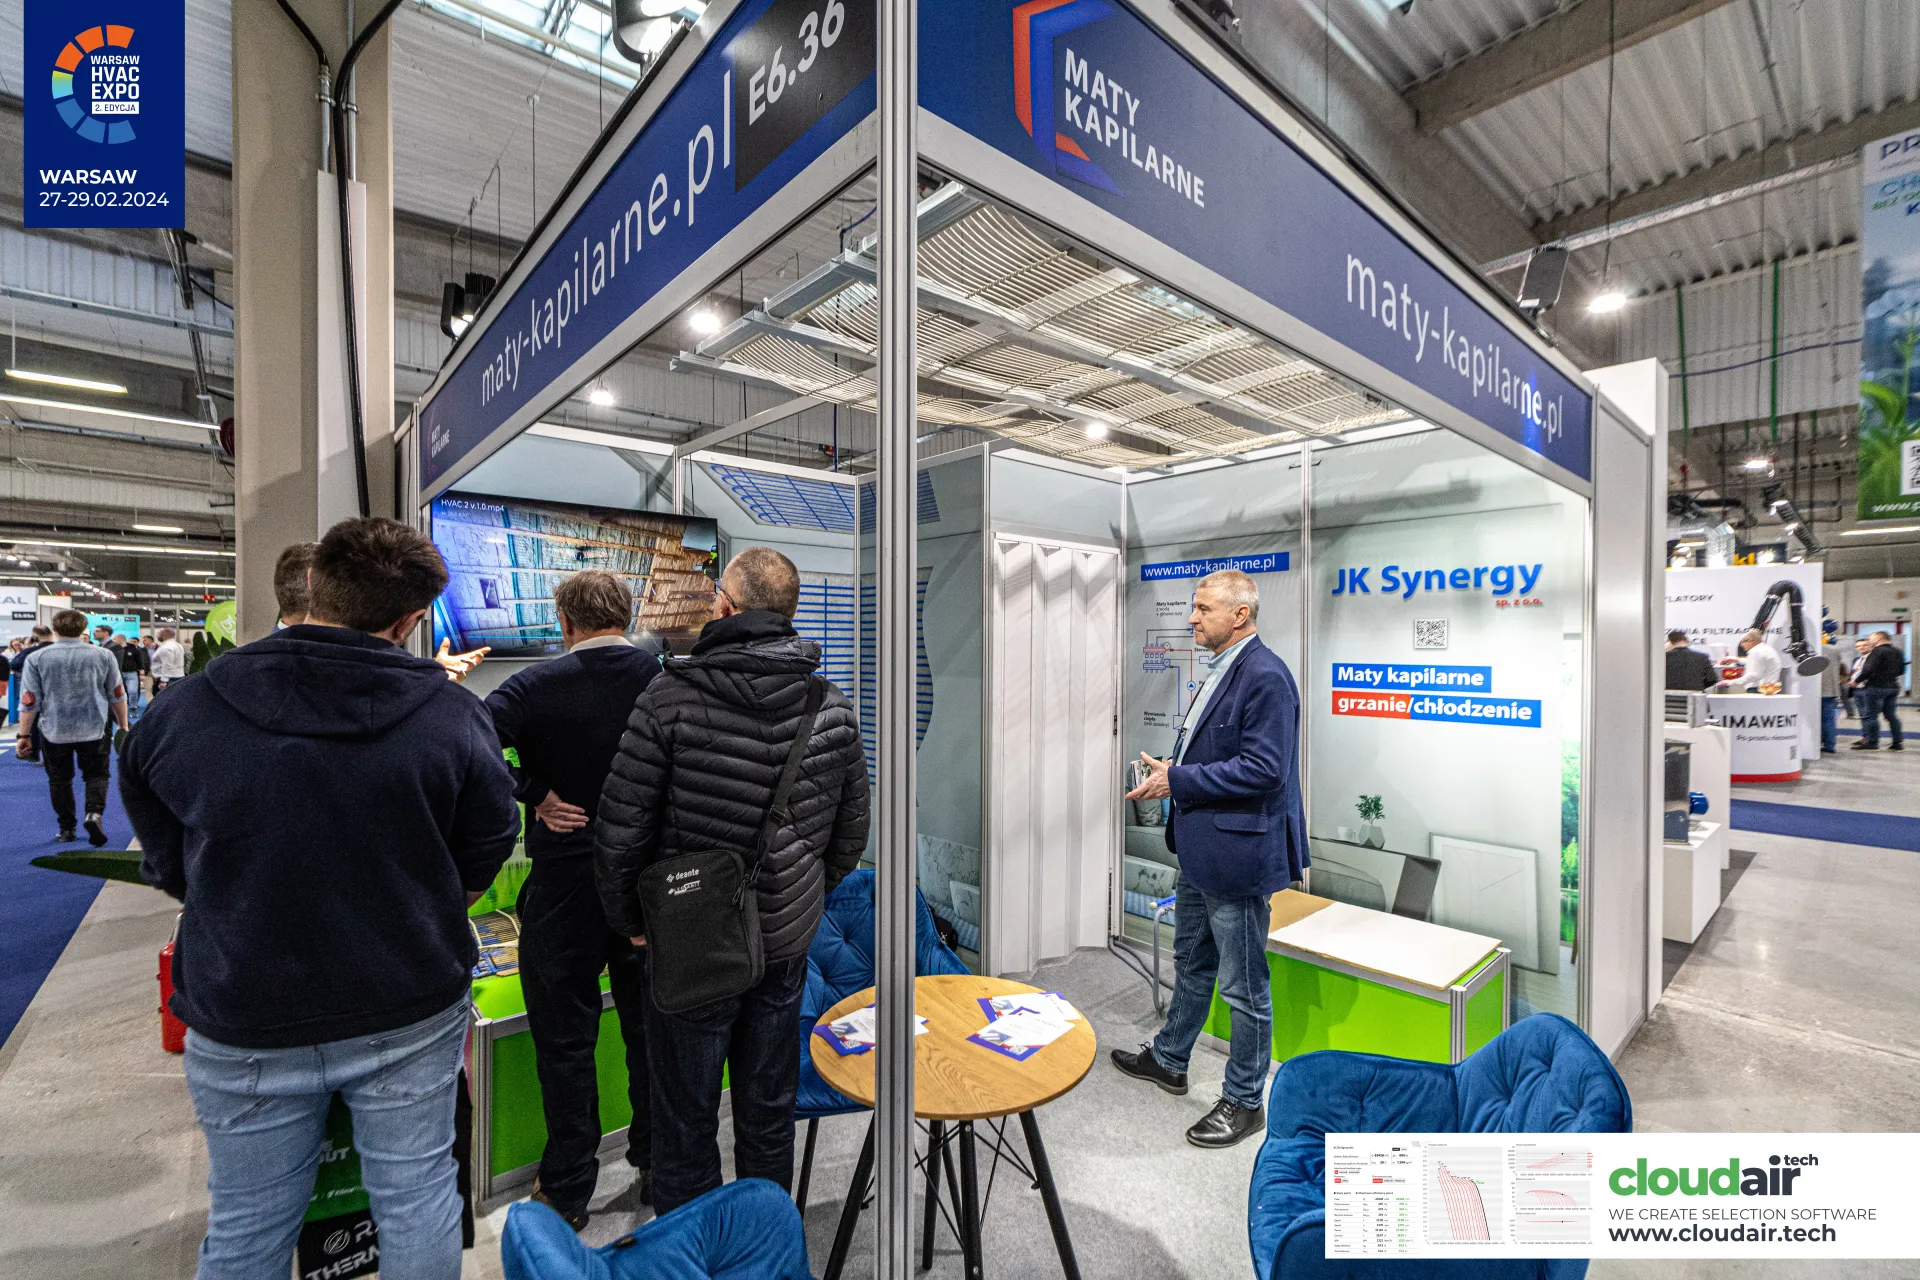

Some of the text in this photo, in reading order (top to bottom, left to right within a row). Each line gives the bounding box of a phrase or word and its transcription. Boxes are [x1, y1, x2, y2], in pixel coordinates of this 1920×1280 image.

[749, 0, 845, 126] E6.36
[1065, 48, 1140, 127] MATY
[1065, 88, 1205, 208] KAPILARNE
[482, 70, 731, 406] maty-kapilarne.pl
[1347, 253, 1562, 443] maty-kapilarne.pl
[441, 499, 462, 508] HVAC
[464, 501, 469, 509] 2
[1144, 555, 1275, 576] www.maty-kapilarne.pl
[1332, 563, 1543, 599] JK Synergy
[1338, 666, 1484, 687] Maty kapilarne
[1338, 696, 1532, 721] grzanie/chłodzenie
